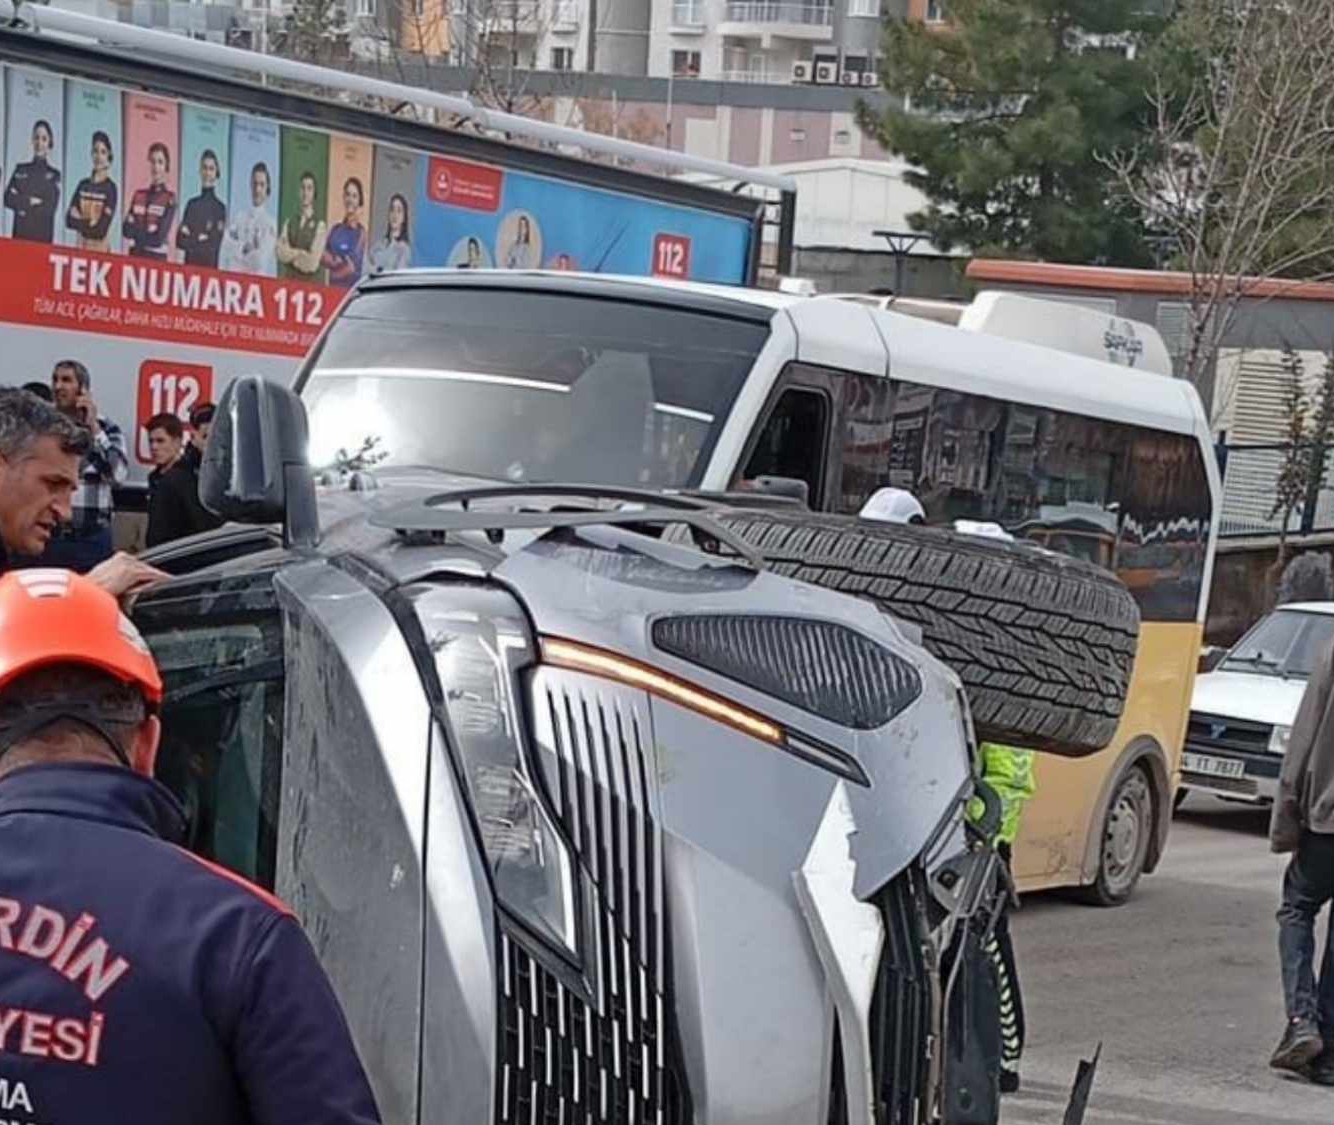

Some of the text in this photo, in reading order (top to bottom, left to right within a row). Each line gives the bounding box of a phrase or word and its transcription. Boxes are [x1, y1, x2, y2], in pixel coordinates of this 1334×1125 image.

[659, 241, 684, 273] 112
[48, 253, 323, 325] TEK NUMARA 112
[149, 373, 200, 423] 112
